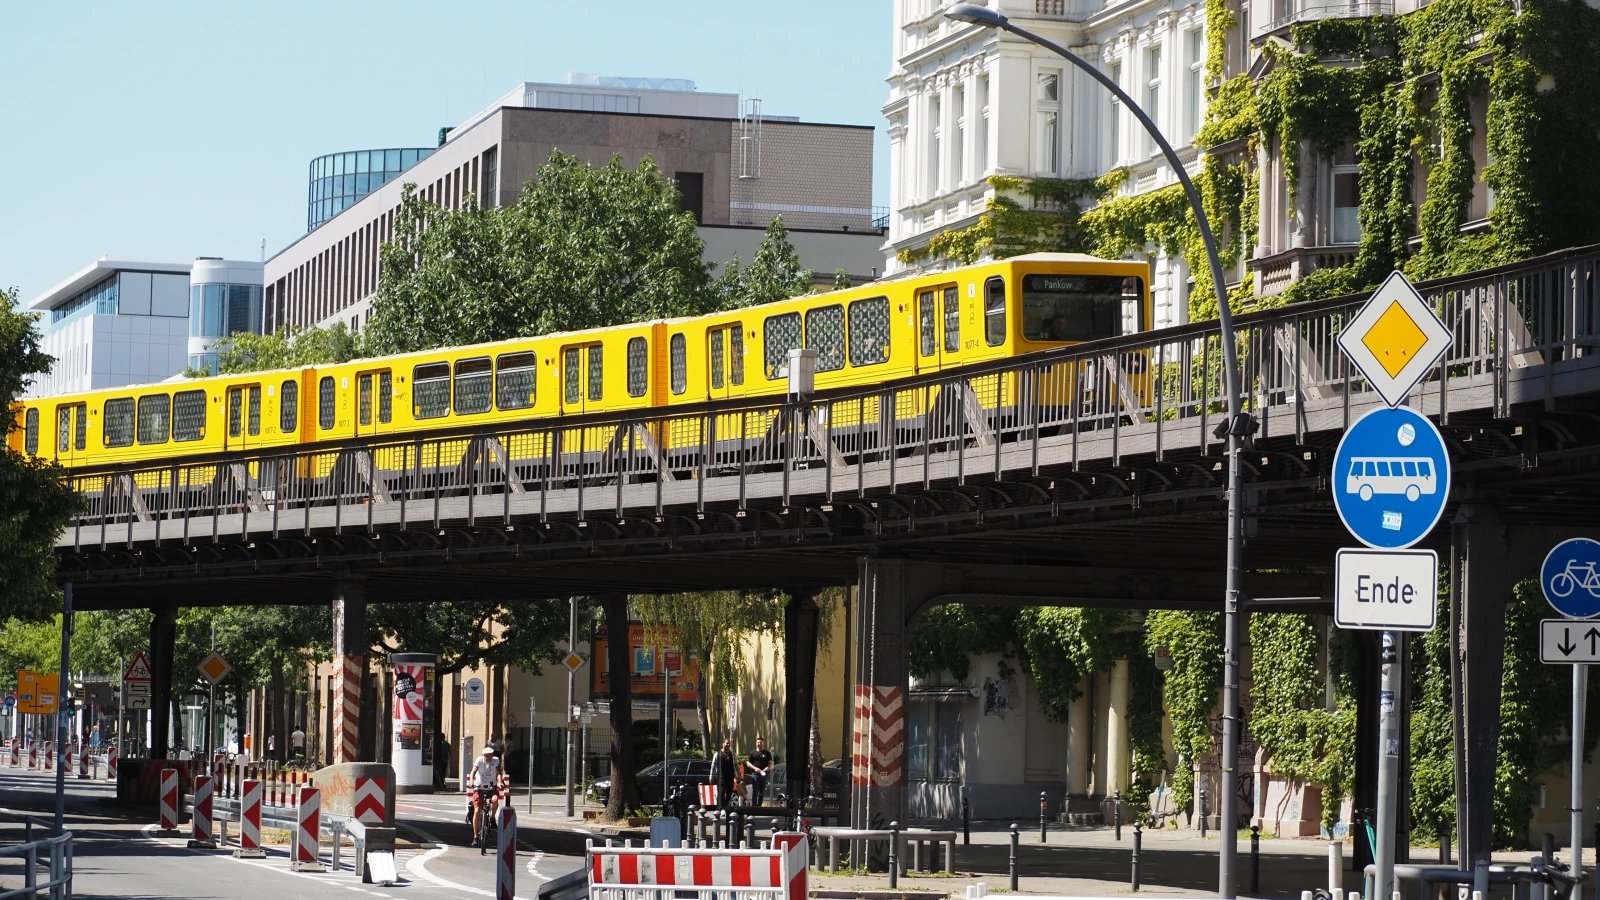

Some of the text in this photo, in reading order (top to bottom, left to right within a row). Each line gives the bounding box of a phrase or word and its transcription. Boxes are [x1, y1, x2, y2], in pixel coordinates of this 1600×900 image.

[1044, 279, 1073, 290] Pankow
[965, 339, 980, 350] 1077-4
[1356, 574, 1414, 604] Ende
